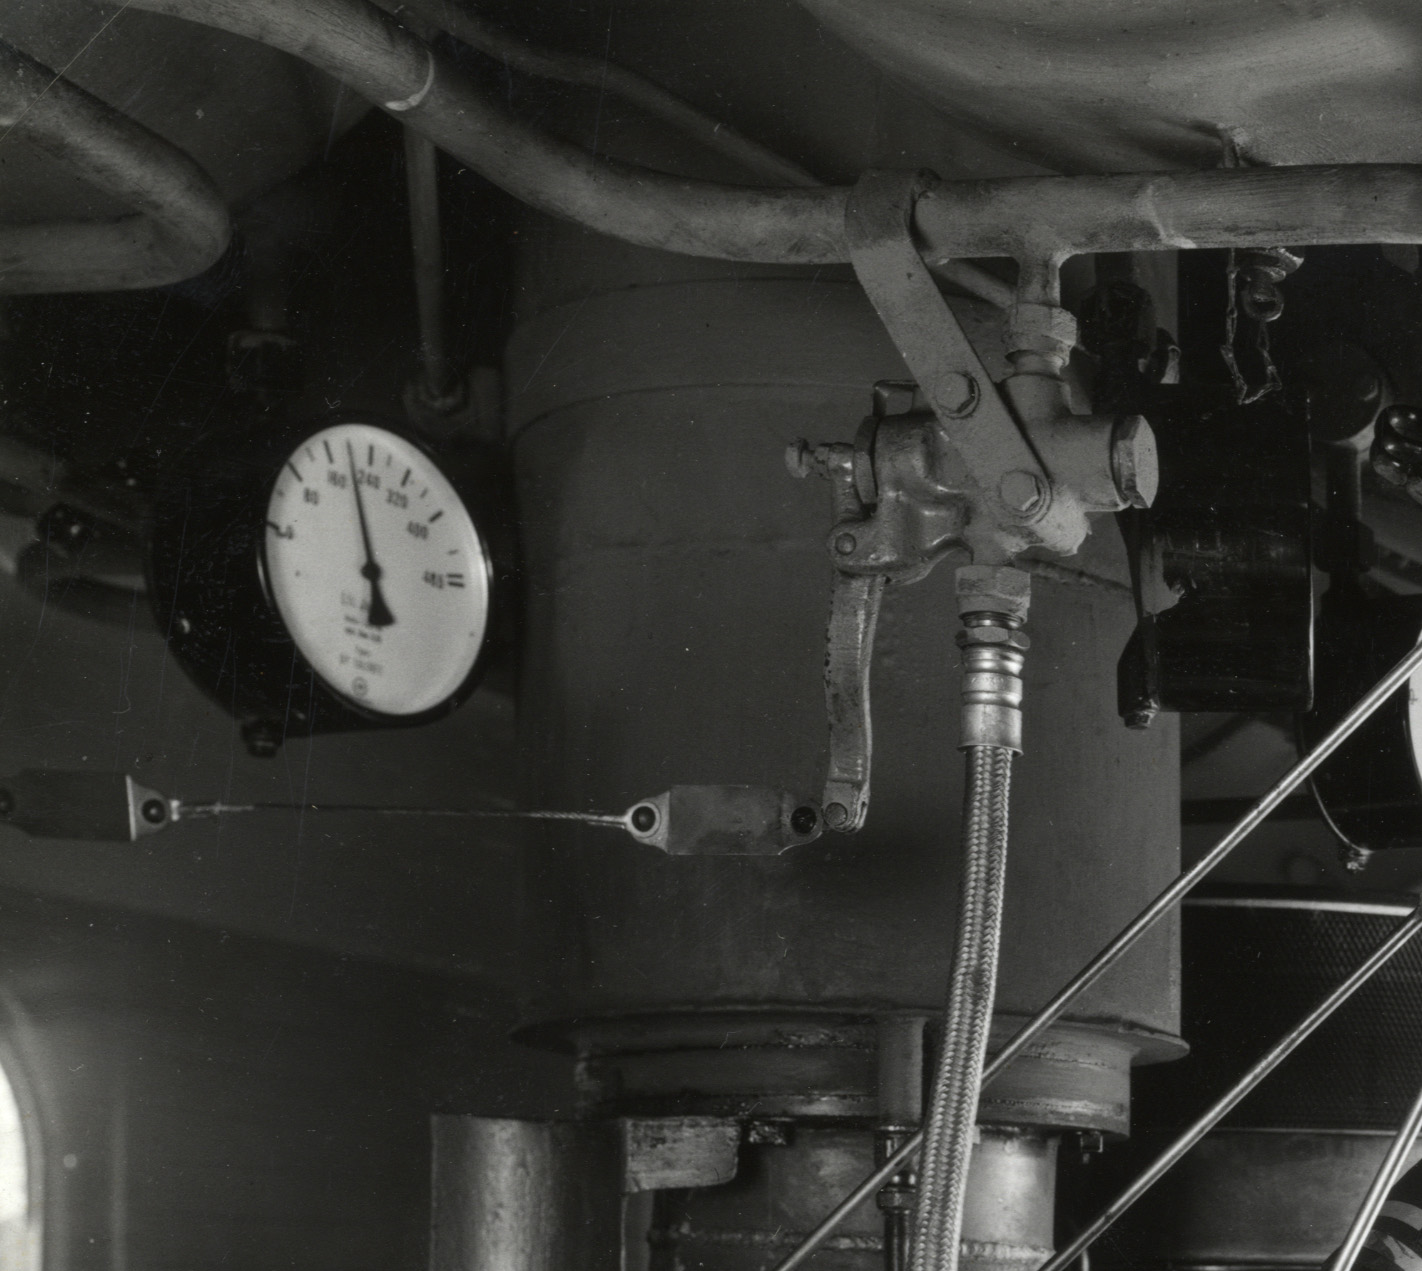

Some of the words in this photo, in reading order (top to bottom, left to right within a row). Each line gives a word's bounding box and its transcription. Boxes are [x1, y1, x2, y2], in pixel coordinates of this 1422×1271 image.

[328, 470, 347, 489] 160
[356, 469, 381, 489] 240
[303, 487, 319, 506] 80
[386, 489, 409, 509] 320
[407, 520, 429, 541] 400
